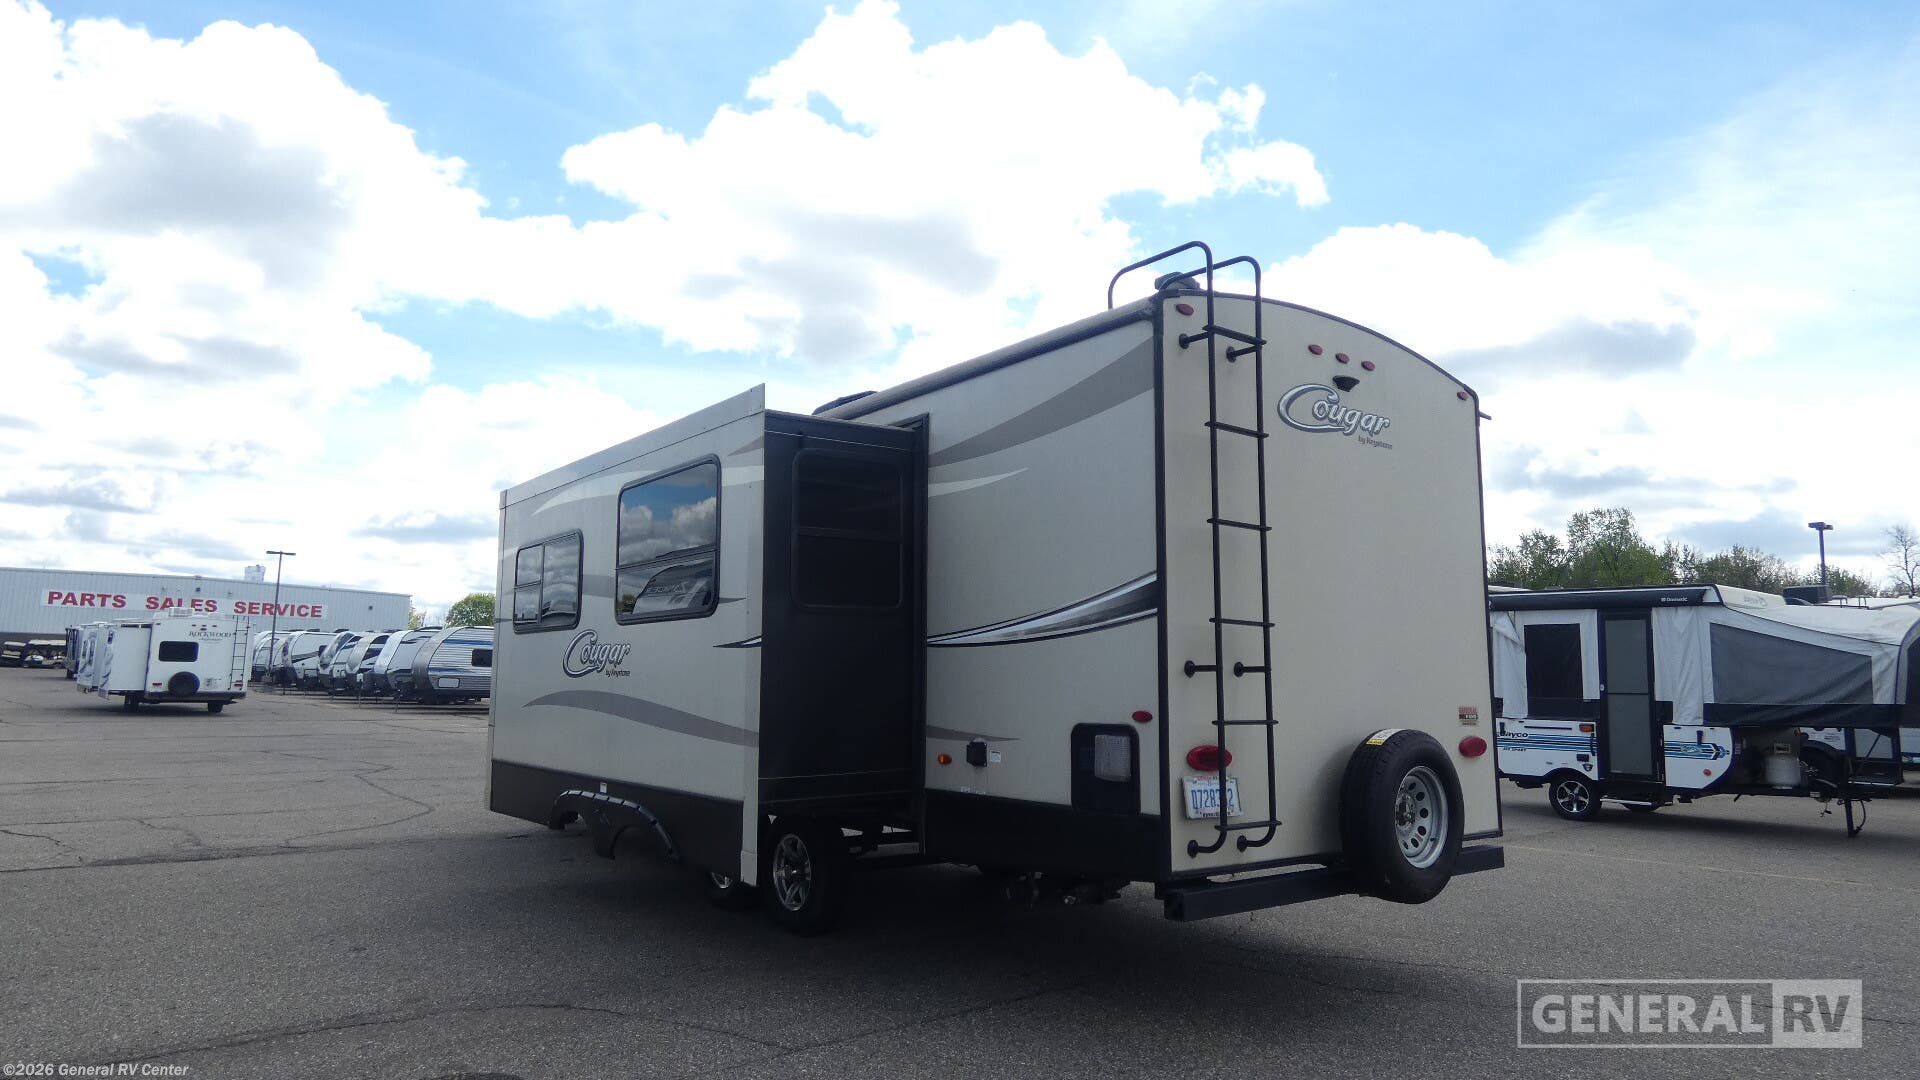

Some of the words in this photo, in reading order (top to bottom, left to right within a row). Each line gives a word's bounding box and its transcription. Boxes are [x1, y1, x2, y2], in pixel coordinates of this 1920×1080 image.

[1277, 383, 1390, 437] Cougar
[1358, 435, 1366, 444] by
[47, 590, 127, 609] PARTS
[234, 600, 323, 618] SERVICE
[562, 629, 631, 678] Cougar
